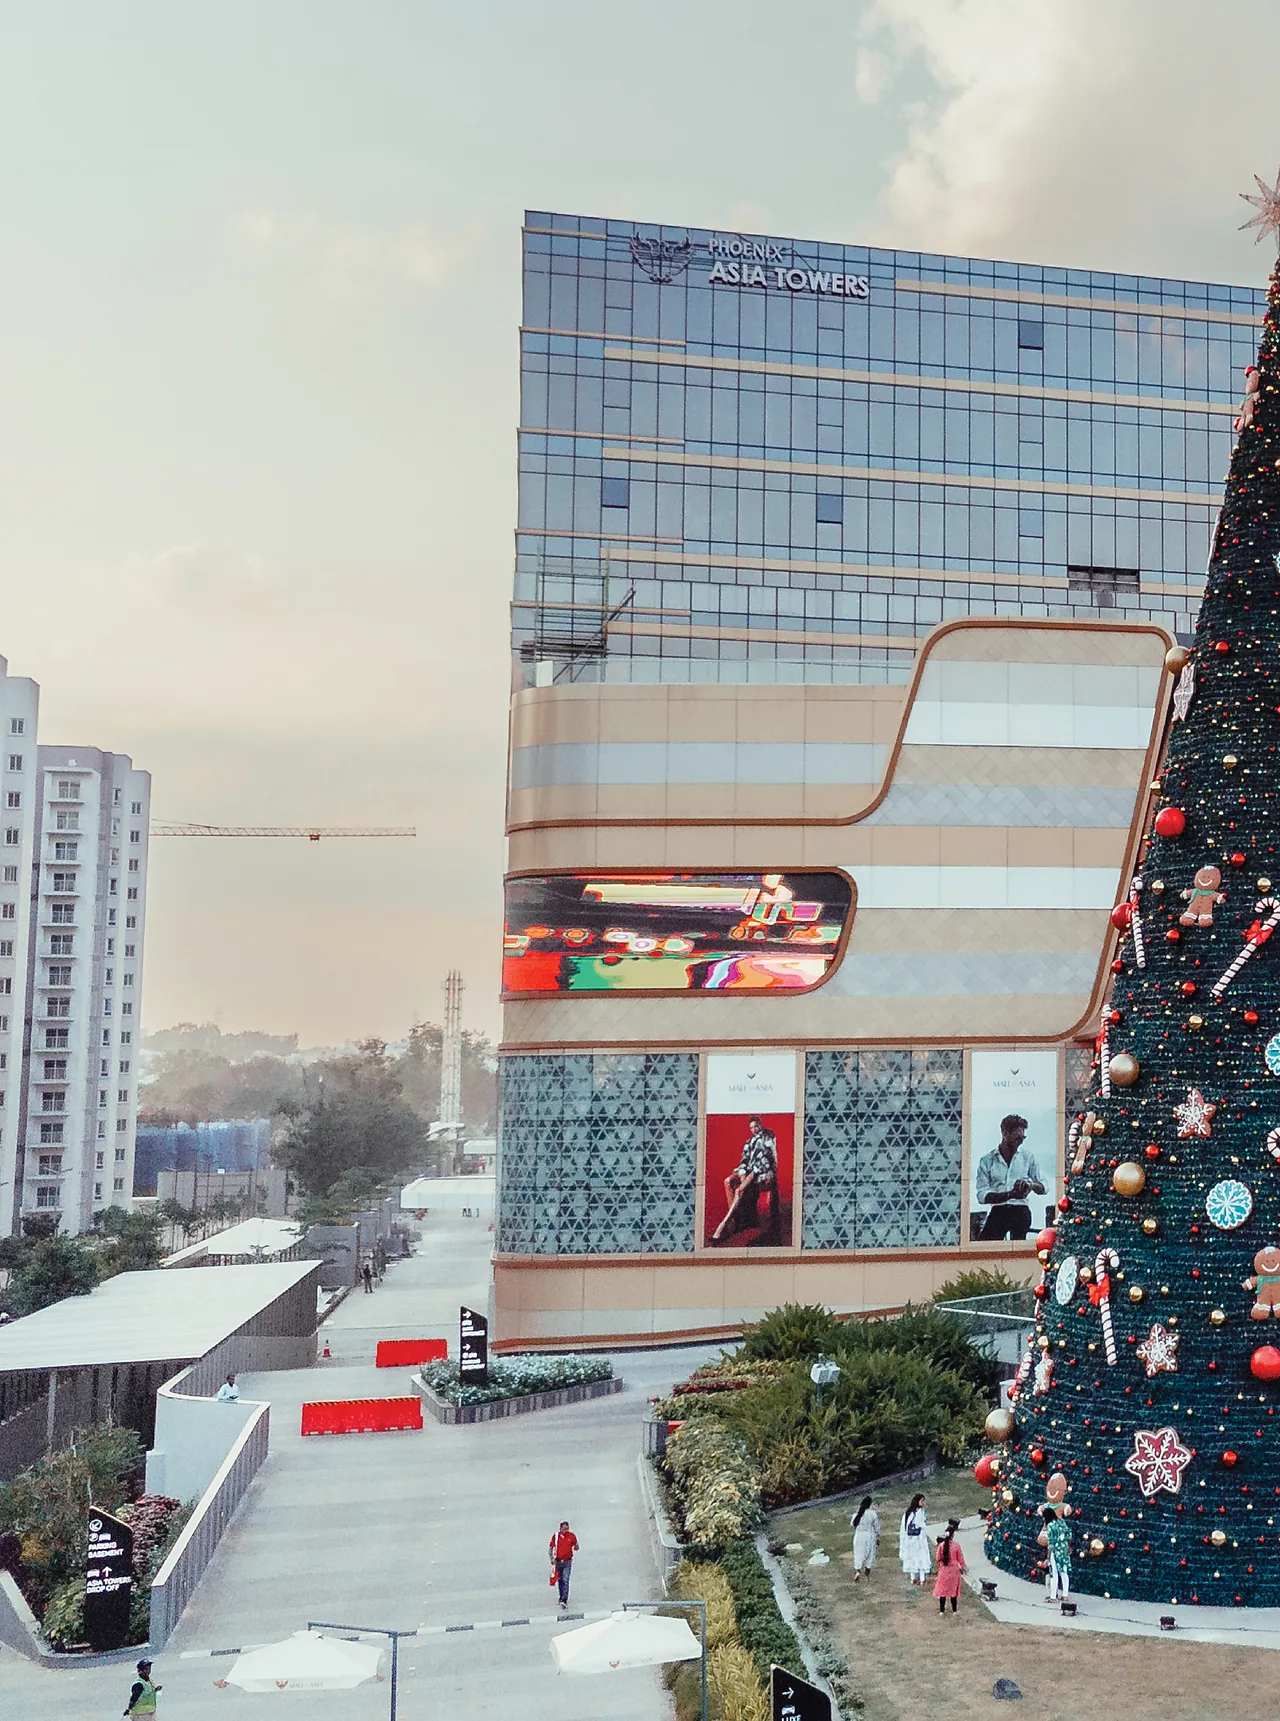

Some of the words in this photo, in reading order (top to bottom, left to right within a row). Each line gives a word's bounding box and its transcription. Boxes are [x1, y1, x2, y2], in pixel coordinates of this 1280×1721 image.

[708, 238, 783, 261] PHOENIX
[709, 261, 768, 287] ASIA
[774, 267, 870, 298] TOWERS
[88, 1549, 124, 1558] BASEMENT
[104, 1577, 131, 1585] TOWERS
